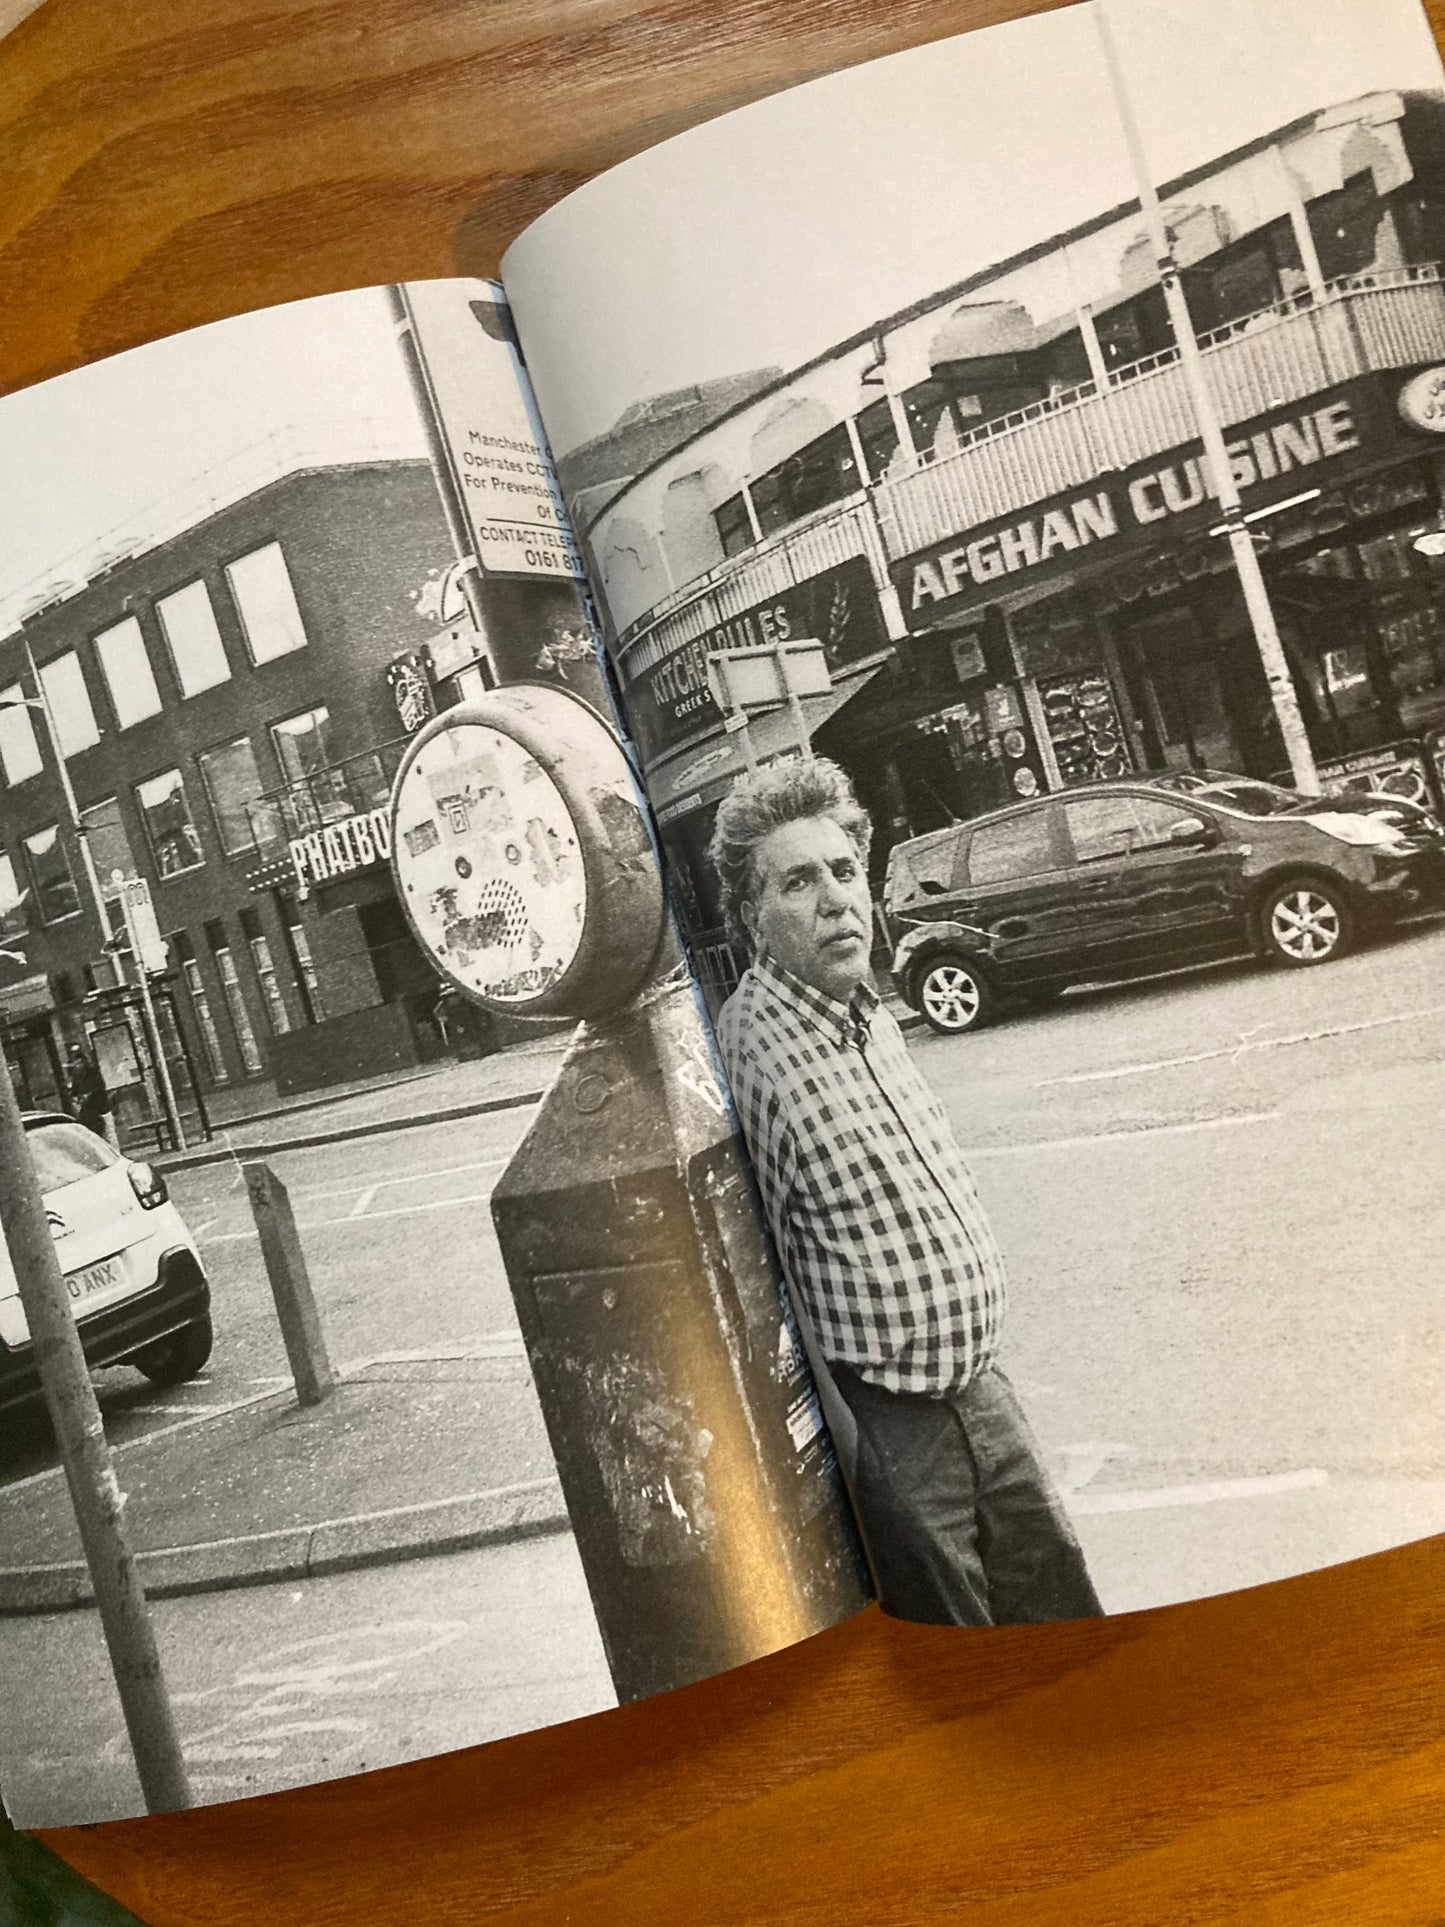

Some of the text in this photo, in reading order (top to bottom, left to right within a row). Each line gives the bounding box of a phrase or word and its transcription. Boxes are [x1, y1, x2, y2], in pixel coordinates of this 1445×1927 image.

[468, 430, 540, 456] Manchester
[463, 452, 524, 473] Operates
[464, 473, 557, 500] For Prevention
[537, 505, 551, 519] Of
[911, 400, 1360, 610] AFGHAN CUISINE
[480, 526, 538, 545] CONTACT
[525, 549, 559, 568] 0161
[674, 693, 702, 718] GREEK
[289, 806, 393, 887] PHATBO
[84, 1263, 118, 1292] ANX
